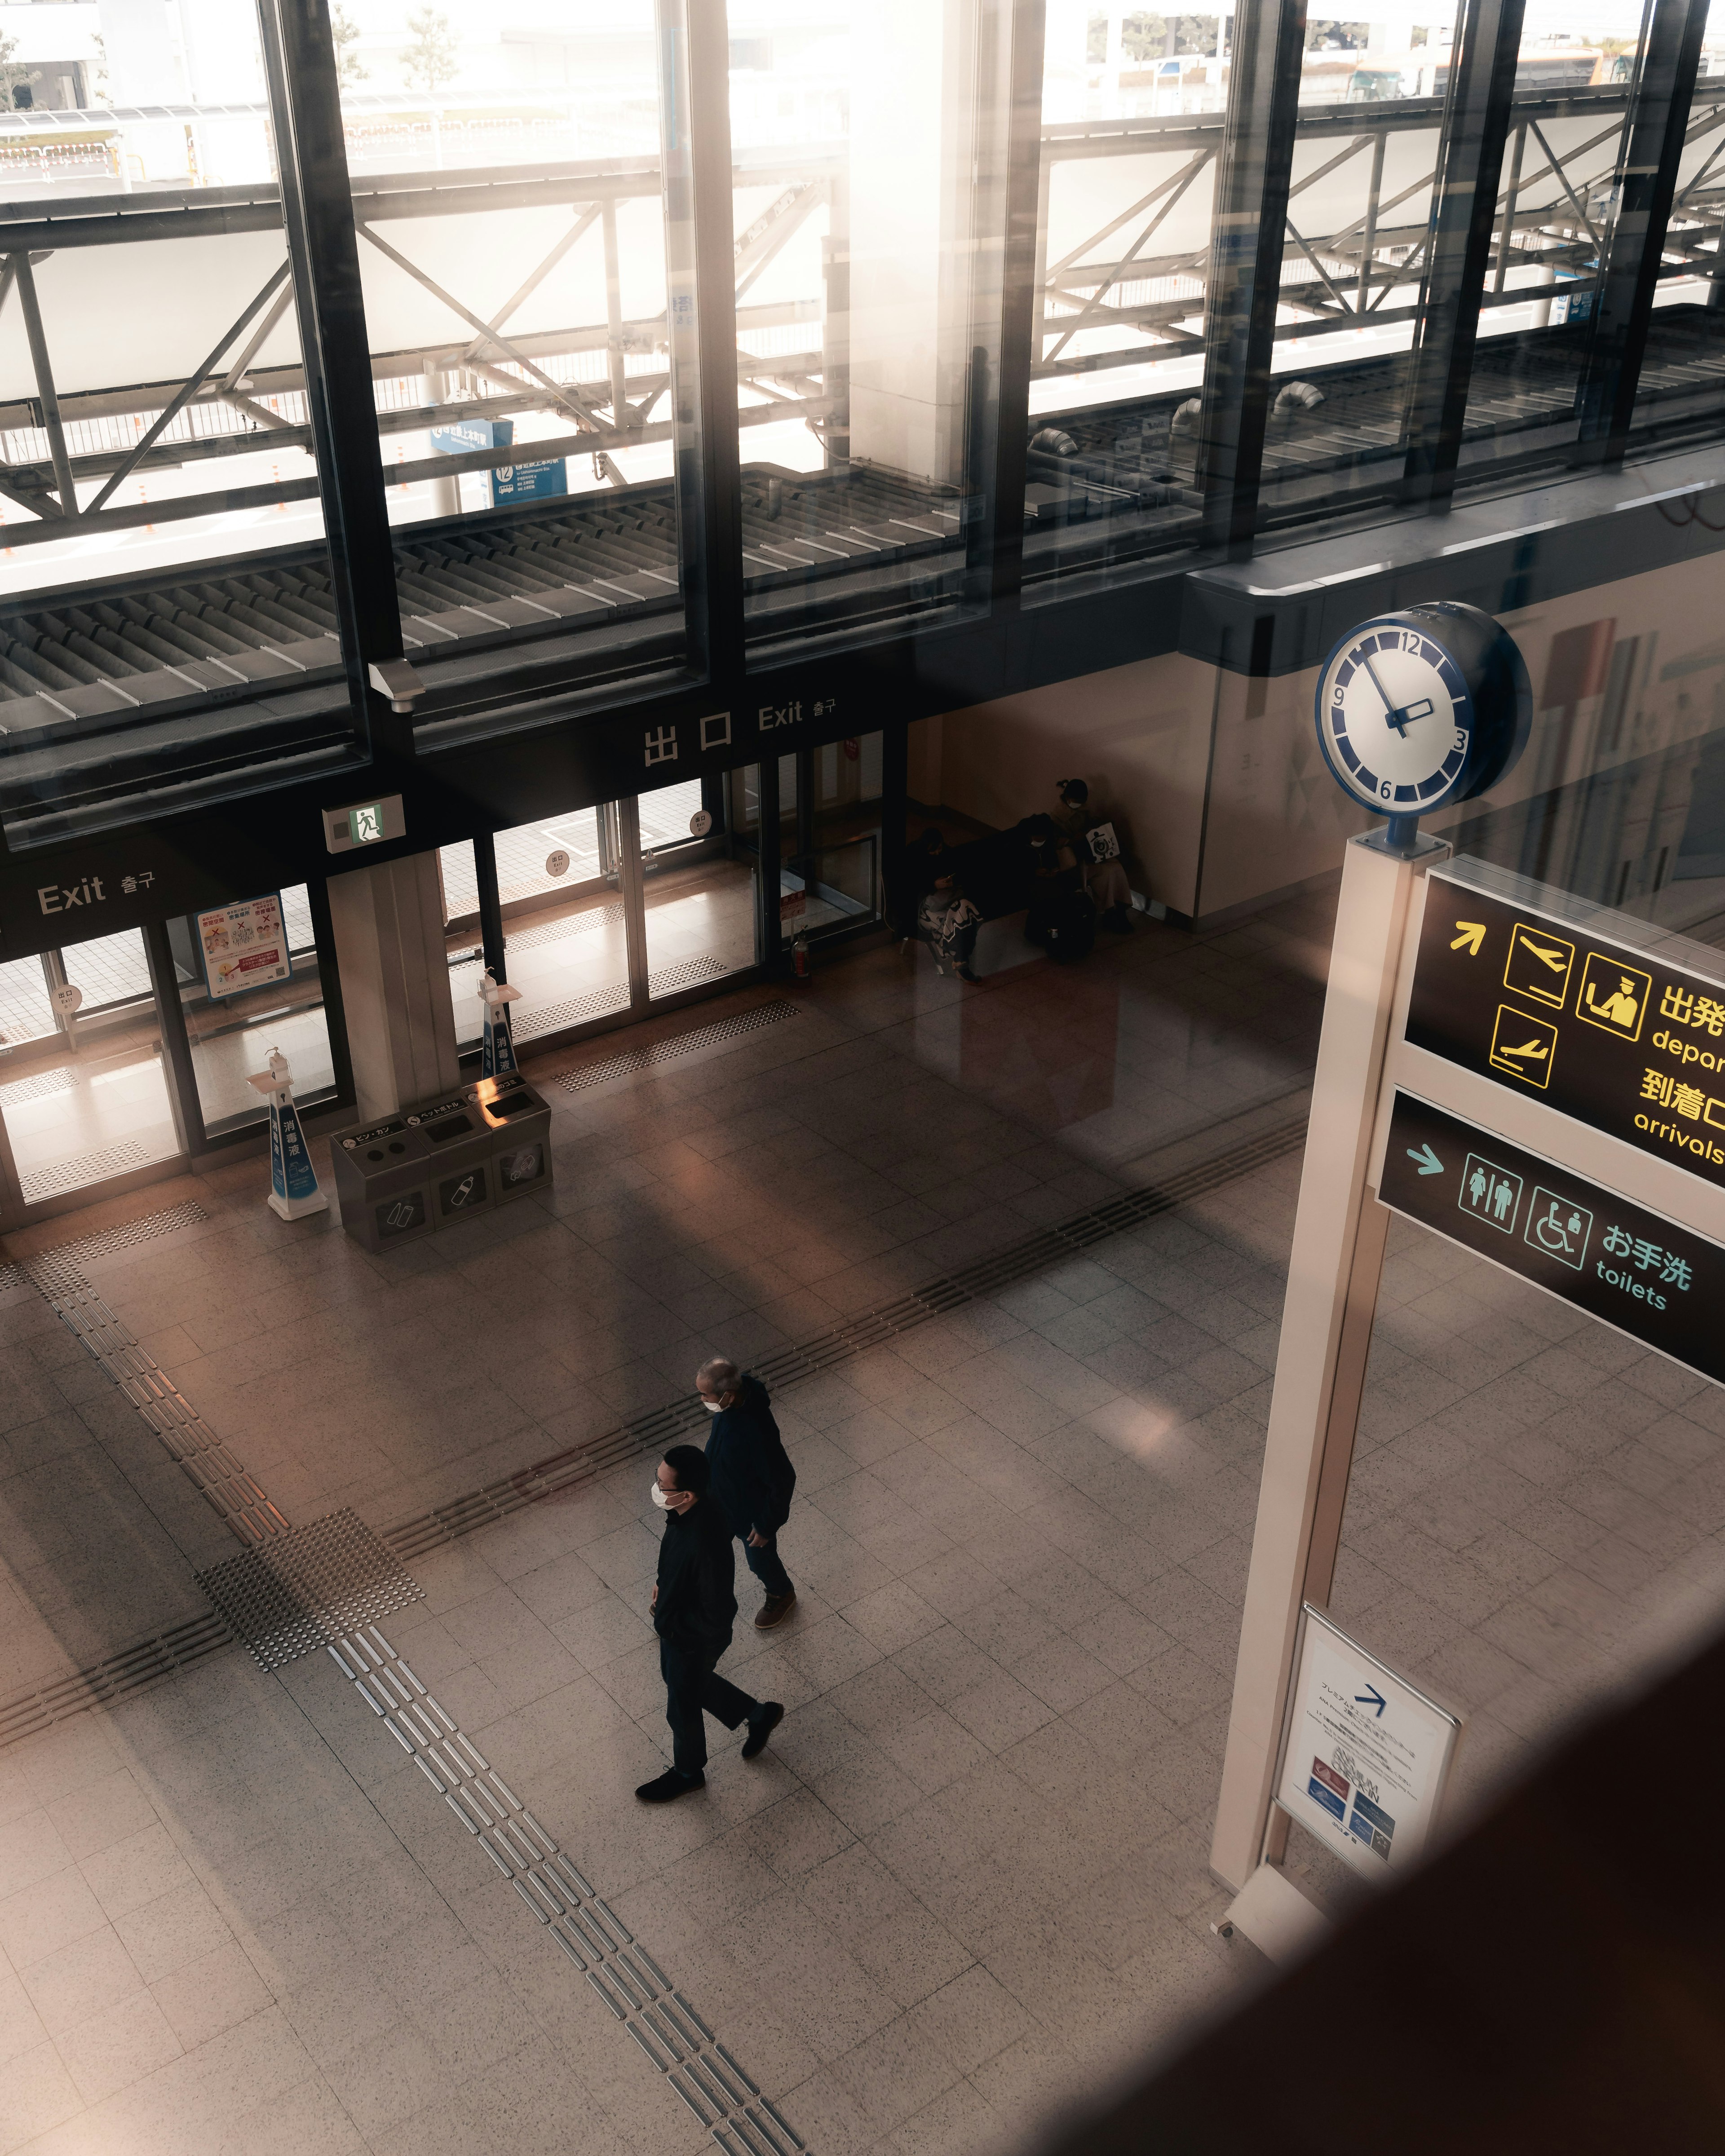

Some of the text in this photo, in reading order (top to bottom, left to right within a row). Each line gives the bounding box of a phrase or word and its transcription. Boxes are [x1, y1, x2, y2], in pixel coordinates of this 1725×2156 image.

[499, 467, 510, 480] 12
[1402, 632, 1420, 656] 12
[1333, 687, 1345, 706] 9
[645, 698, 836, 767] 出口 Exit 출구
[1453, 730, 1466, 751] 3
[1380, 781, 1392, 800] 6
[37, 871, 155, 915] Exit 출구
[203, 919, 225, 928] 密閉空間
[229, 911, 250, 920] 密集場所
[58, 990, 73, 999] 出口
[1660, 985, 1725, 1037] 出発
[496, 1036, 510, 1071] 消毒液
[420, 1100, 459, 1119] ペットボトル
[272, 1118, 280, 1156] 消毒液
[283, 1119, 301, 1157] 消毒液
[355, 1126, 390, 1141] ビン・カン
[1634, 1113, 1725, 1165] arrivals
[1602, 1225, 1692, 1291] お手洗
[1596, 1260, 1667, 1310] toilets
[1319, 1696, 1329, 1706] ANA
[1330, 1704, 1350, 1723] Premium
